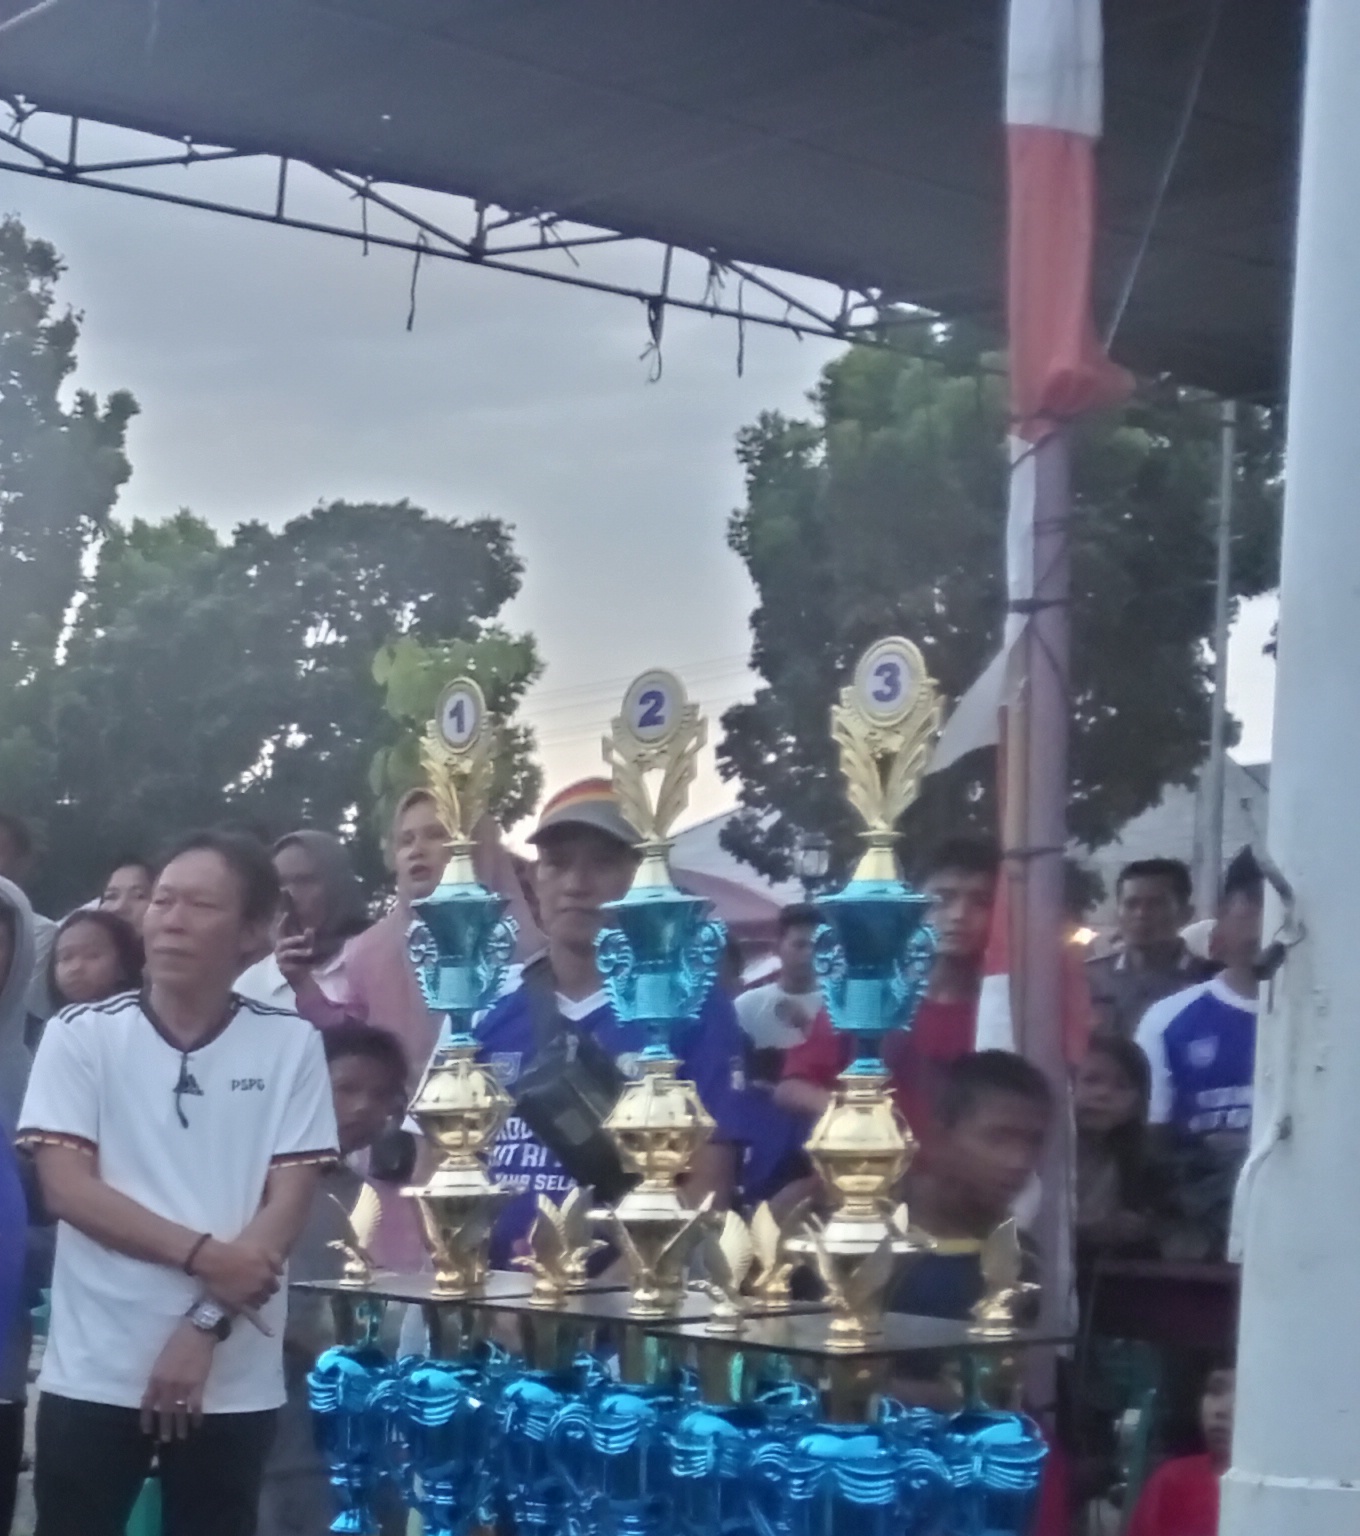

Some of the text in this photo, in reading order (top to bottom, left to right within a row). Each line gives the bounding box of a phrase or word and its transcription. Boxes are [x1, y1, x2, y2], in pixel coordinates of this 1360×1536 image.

[872, 661, 902, 703] 3
[448, 699, 466, 733] 1
[637, 689, 667, 729] 2
[534, 1174, 578, 1192] SELA
